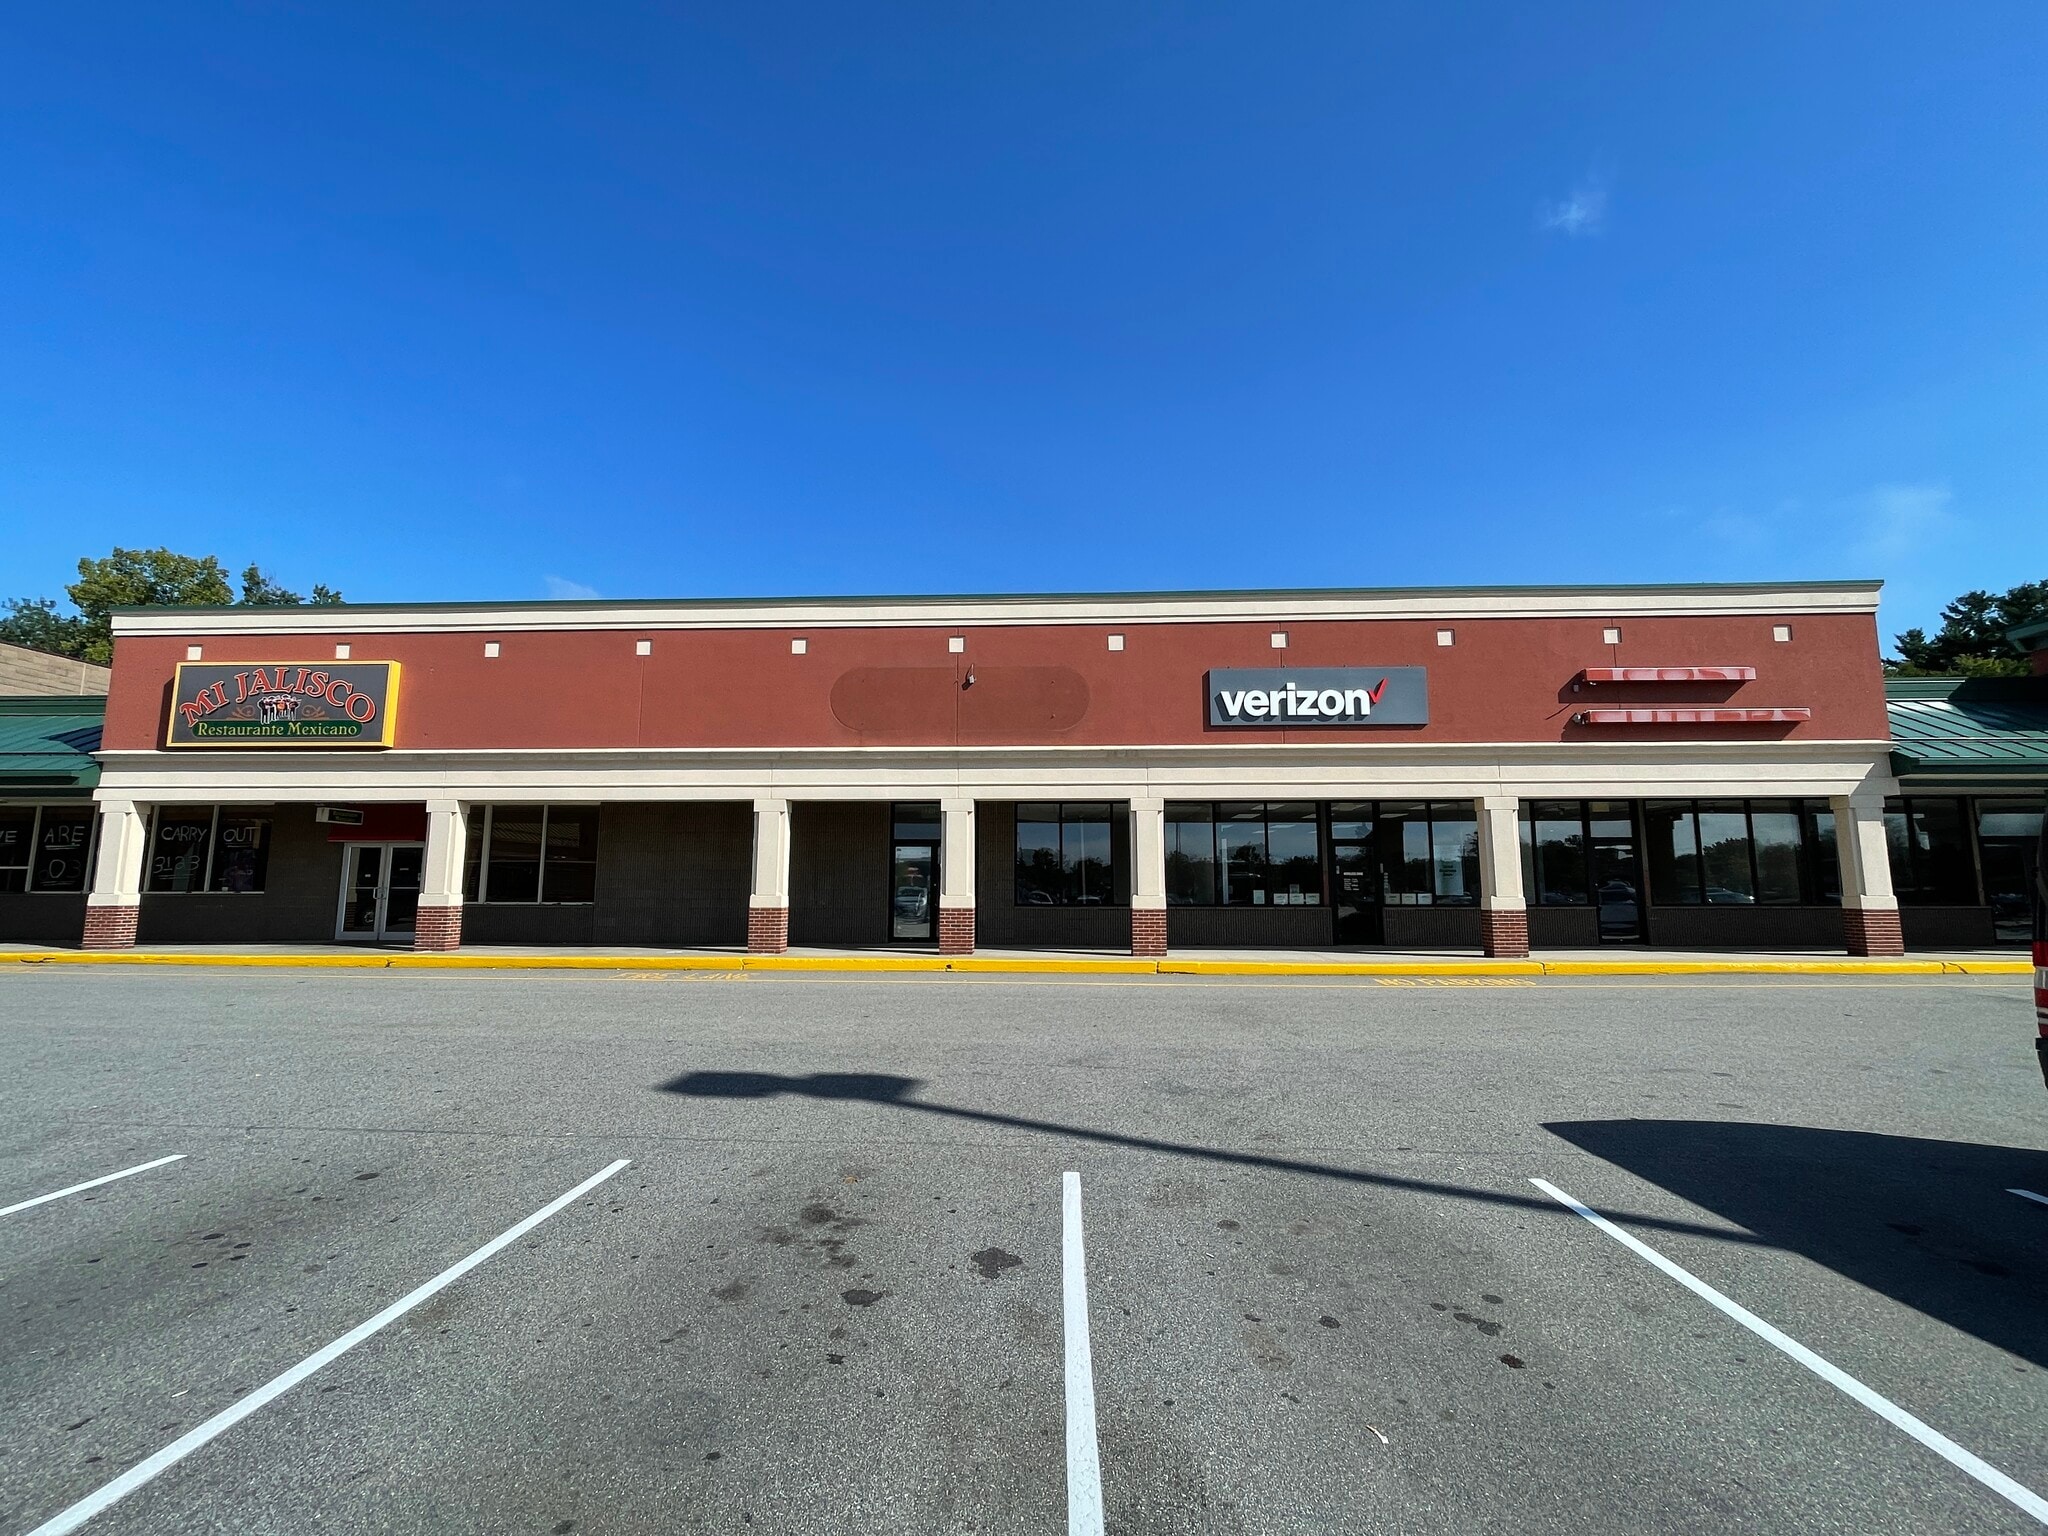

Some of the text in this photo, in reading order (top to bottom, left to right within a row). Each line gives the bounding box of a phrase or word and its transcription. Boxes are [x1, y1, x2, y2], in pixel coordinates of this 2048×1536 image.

[179, 667, 376, 727] MI JALISCO
[1220, 682, 1371, 717] verizon
[198, 722, 357, 736] Restaurante Mexicano
[44, 825, 85, 843] ARE
[161, 825, 260, 842] CARRY OUT
